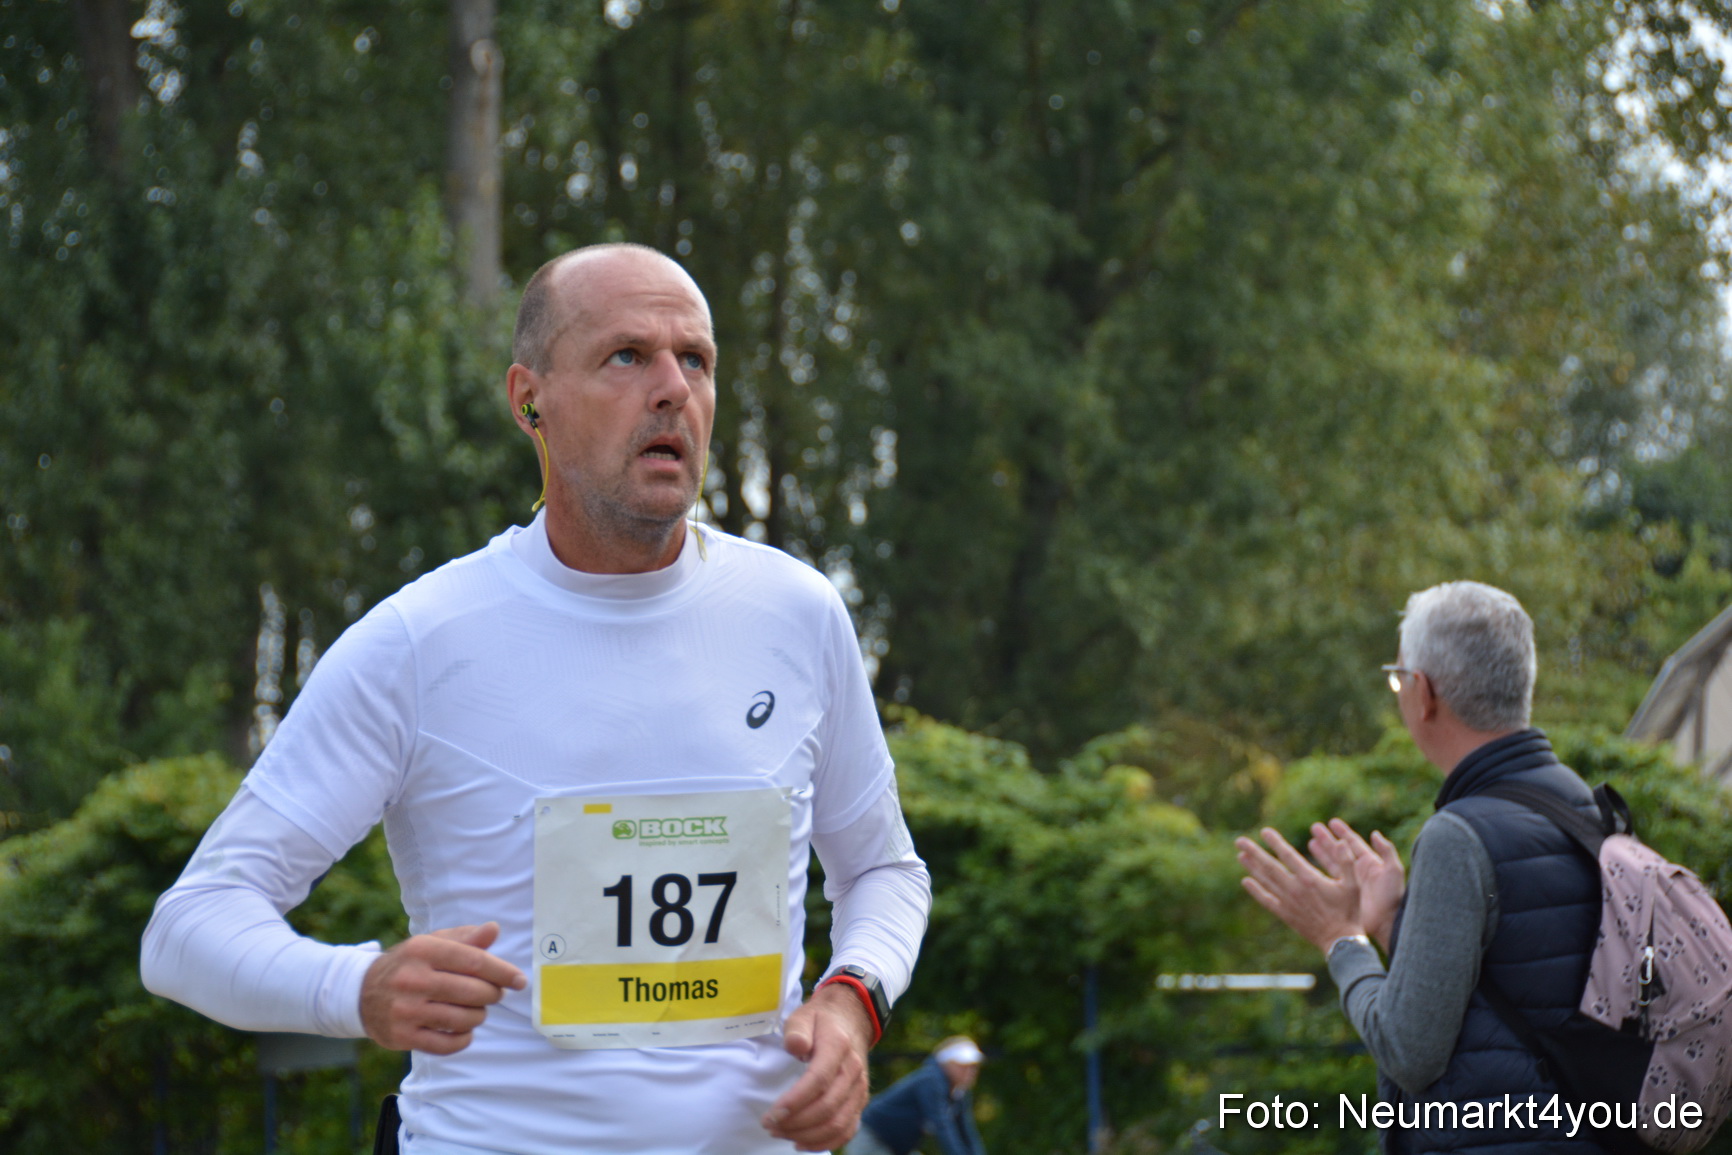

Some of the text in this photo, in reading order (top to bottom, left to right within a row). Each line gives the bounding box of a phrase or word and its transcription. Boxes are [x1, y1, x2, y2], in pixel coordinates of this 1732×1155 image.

[639, 817, 728, 839] BOCK
[603, 871, 737, 947] 187
[548, 940, 558, 954] A
[618, 977, 719, 1002] Thomas
